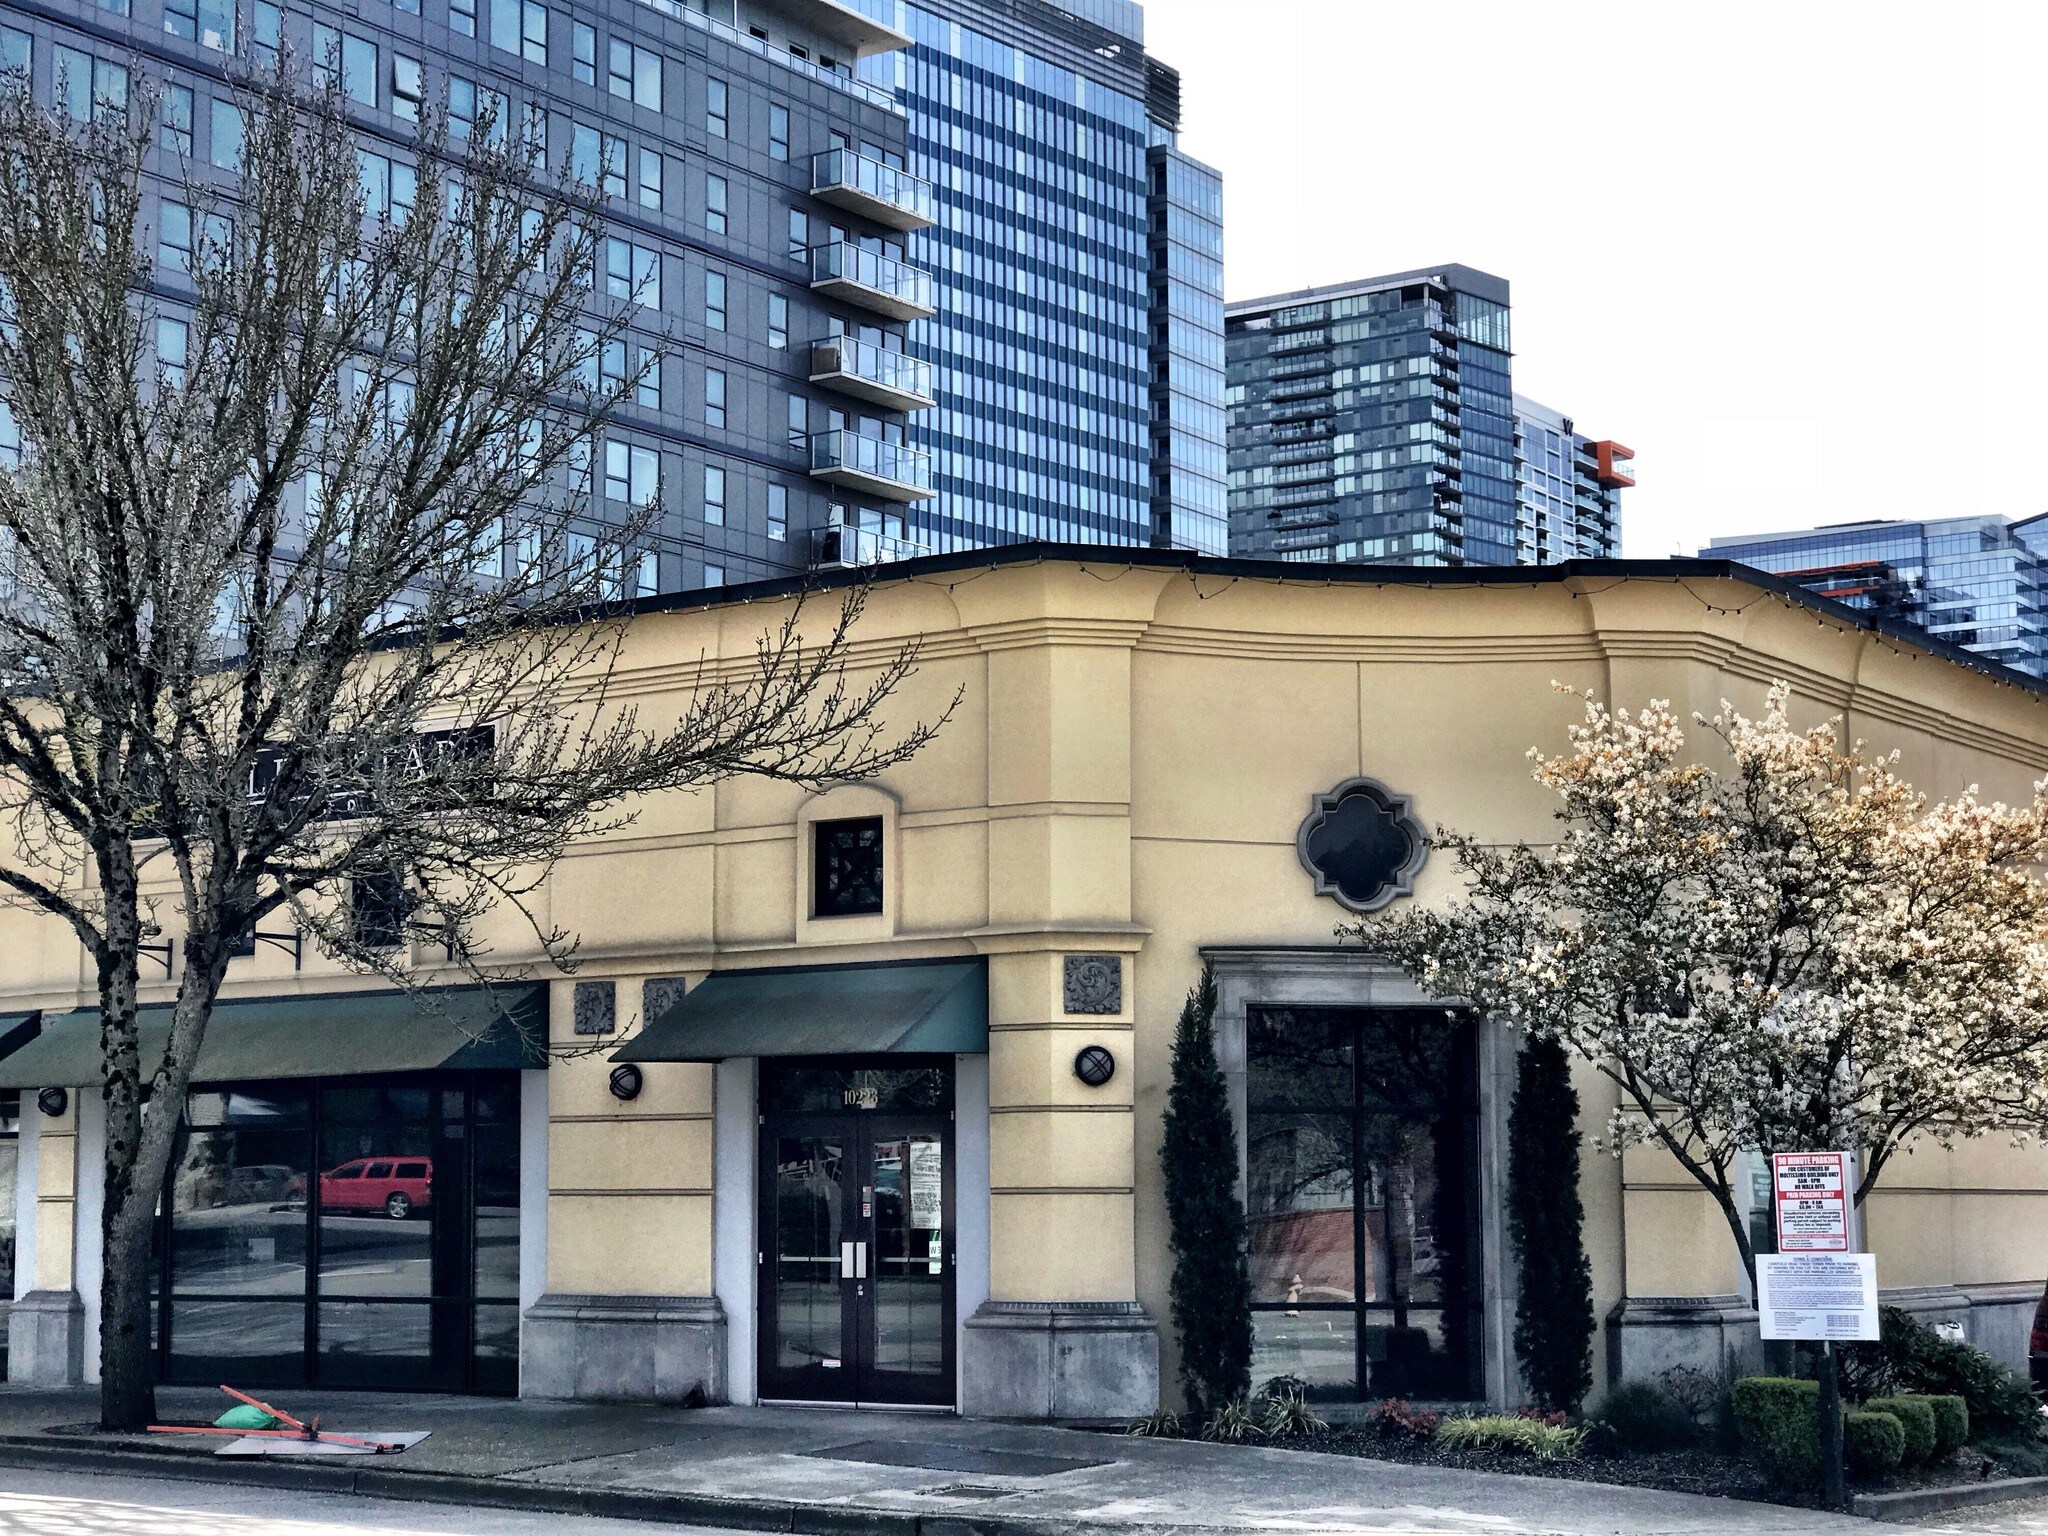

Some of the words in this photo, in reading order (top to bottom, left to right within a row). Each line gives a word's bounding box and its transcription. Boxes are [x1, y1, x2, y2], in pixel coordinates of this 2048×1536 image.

[1563, 418, 1574, 437] W
[1778, 1157, 1787, 1166] 90
[1788, 1156, 1811, 1165] MINUTE
[1812, 1156, 1840, 1164] PARKING
